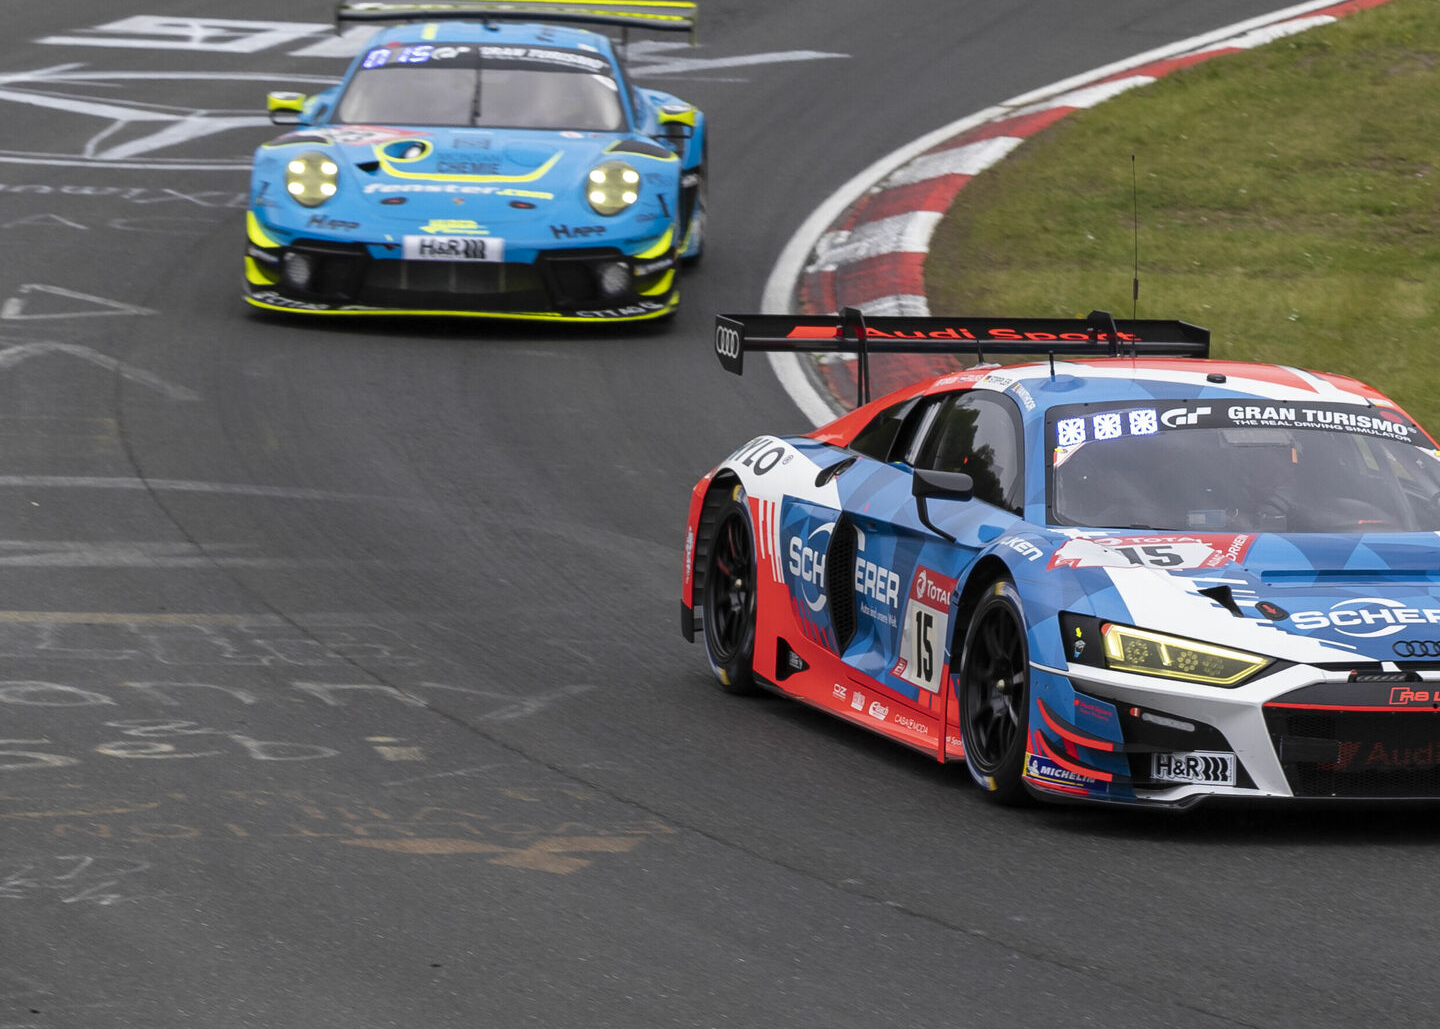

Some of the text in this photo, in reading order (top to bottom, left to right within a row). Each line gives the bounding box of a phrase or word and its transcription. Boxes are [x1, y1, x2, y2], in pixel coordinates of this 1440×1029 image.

[866, 327, 976, 340] Audi
[1228, 406, 1408, 436] GRAN TURISMO
[1293, 421, 1343, 431] DRIVING
[1344, 425, 1412, 443] SIMULATOR
[1115, 545, 1184, 567] 15
[915, 610, 933, 683] 15
[1157, 755, 1199, 778] H&R
